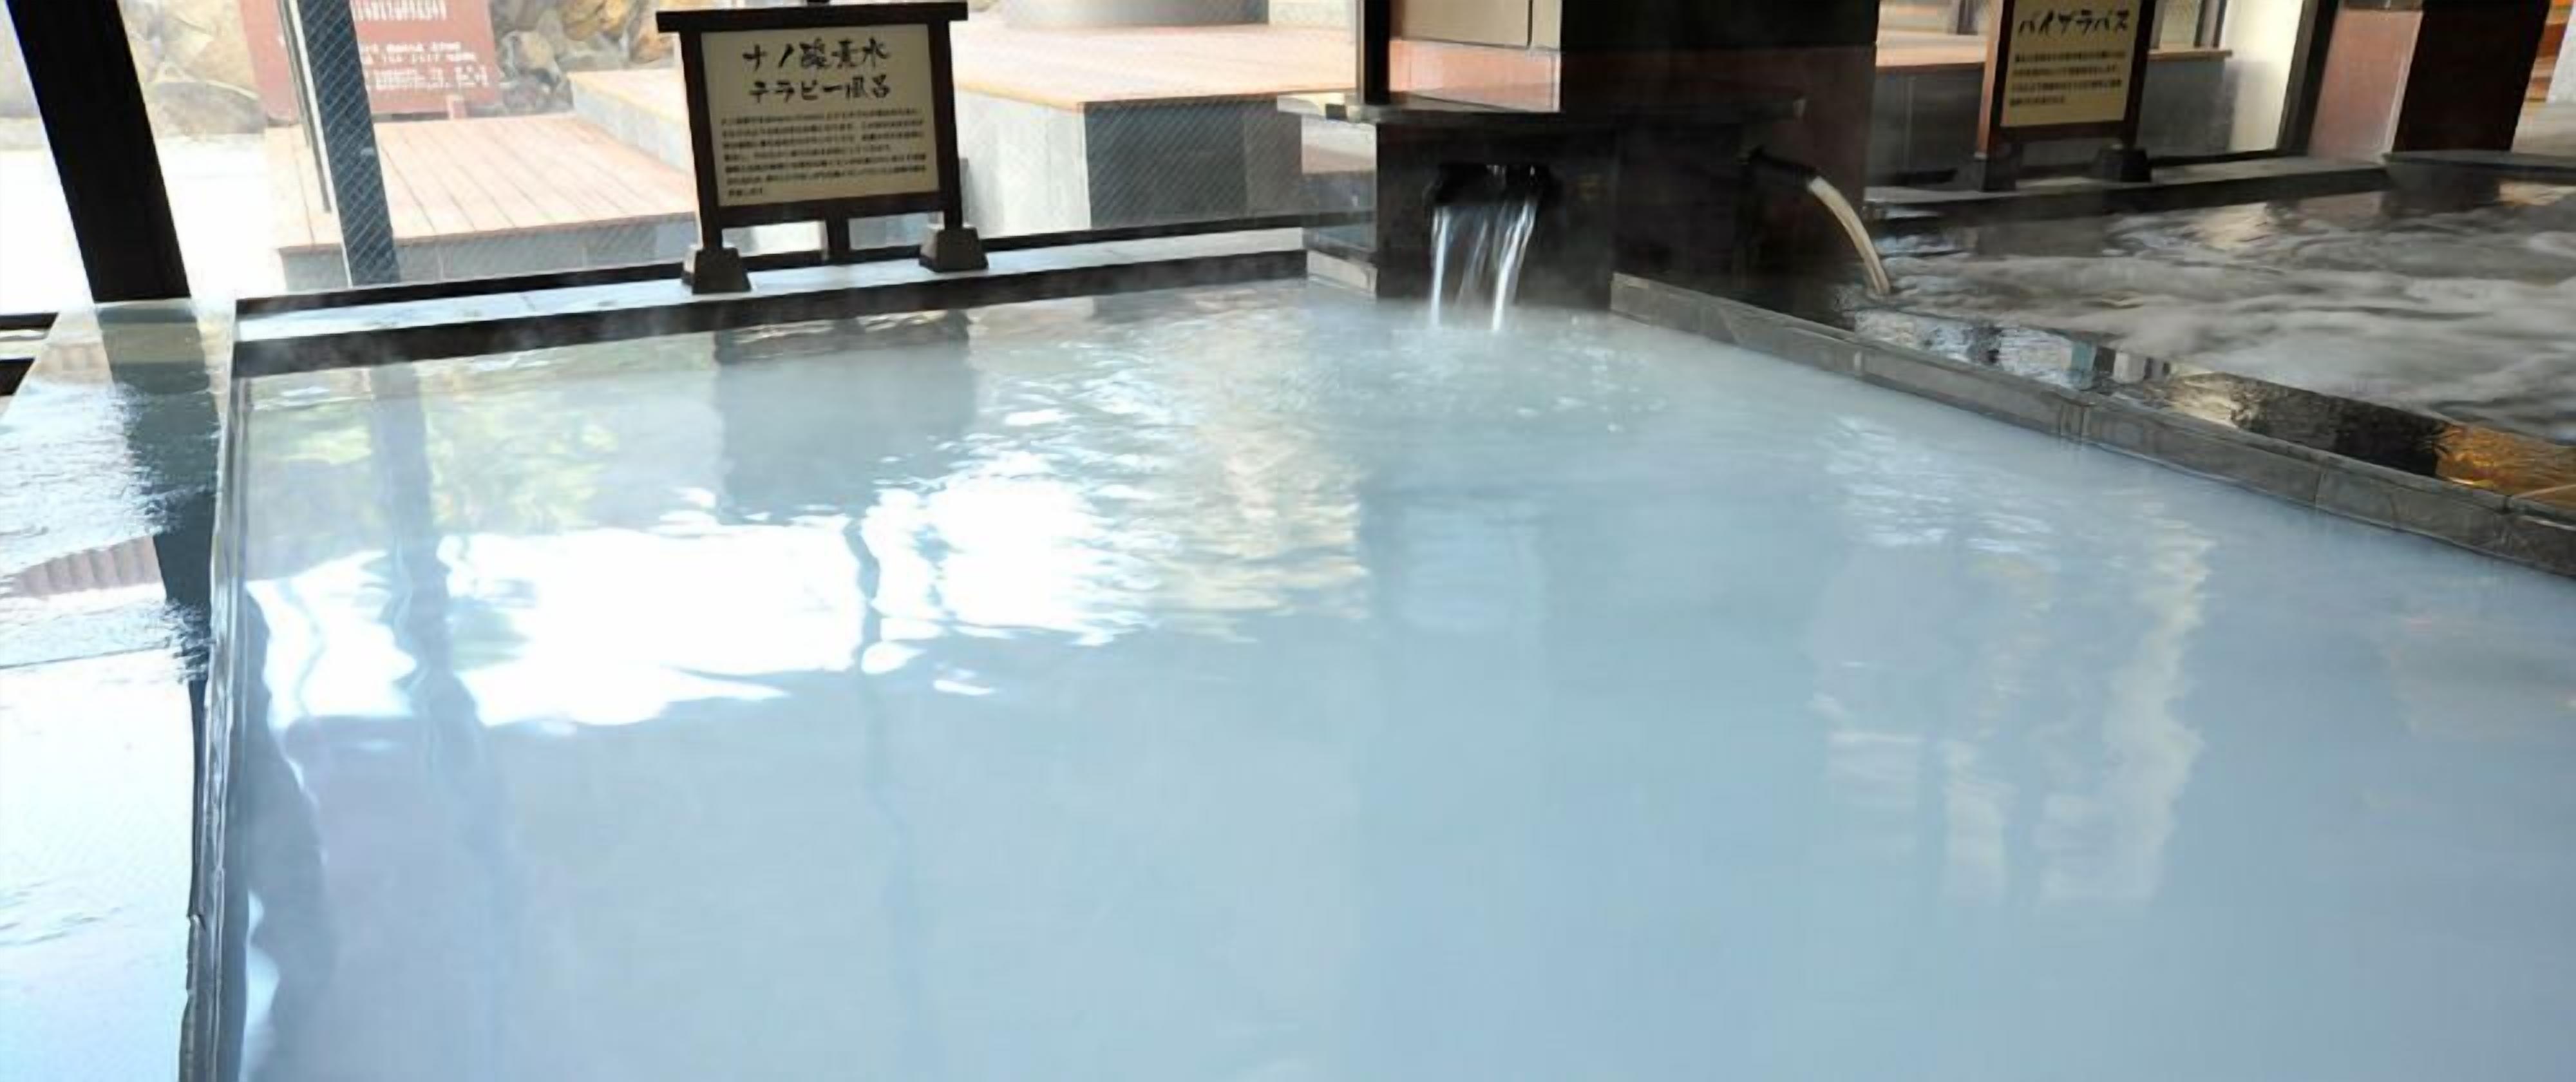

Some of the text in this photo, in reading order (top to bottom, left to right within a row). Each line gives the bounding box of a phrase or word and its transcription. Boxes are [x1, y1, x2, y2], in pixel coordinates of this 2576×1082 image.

[743, 37, 891, 71] ナノ酸素水
